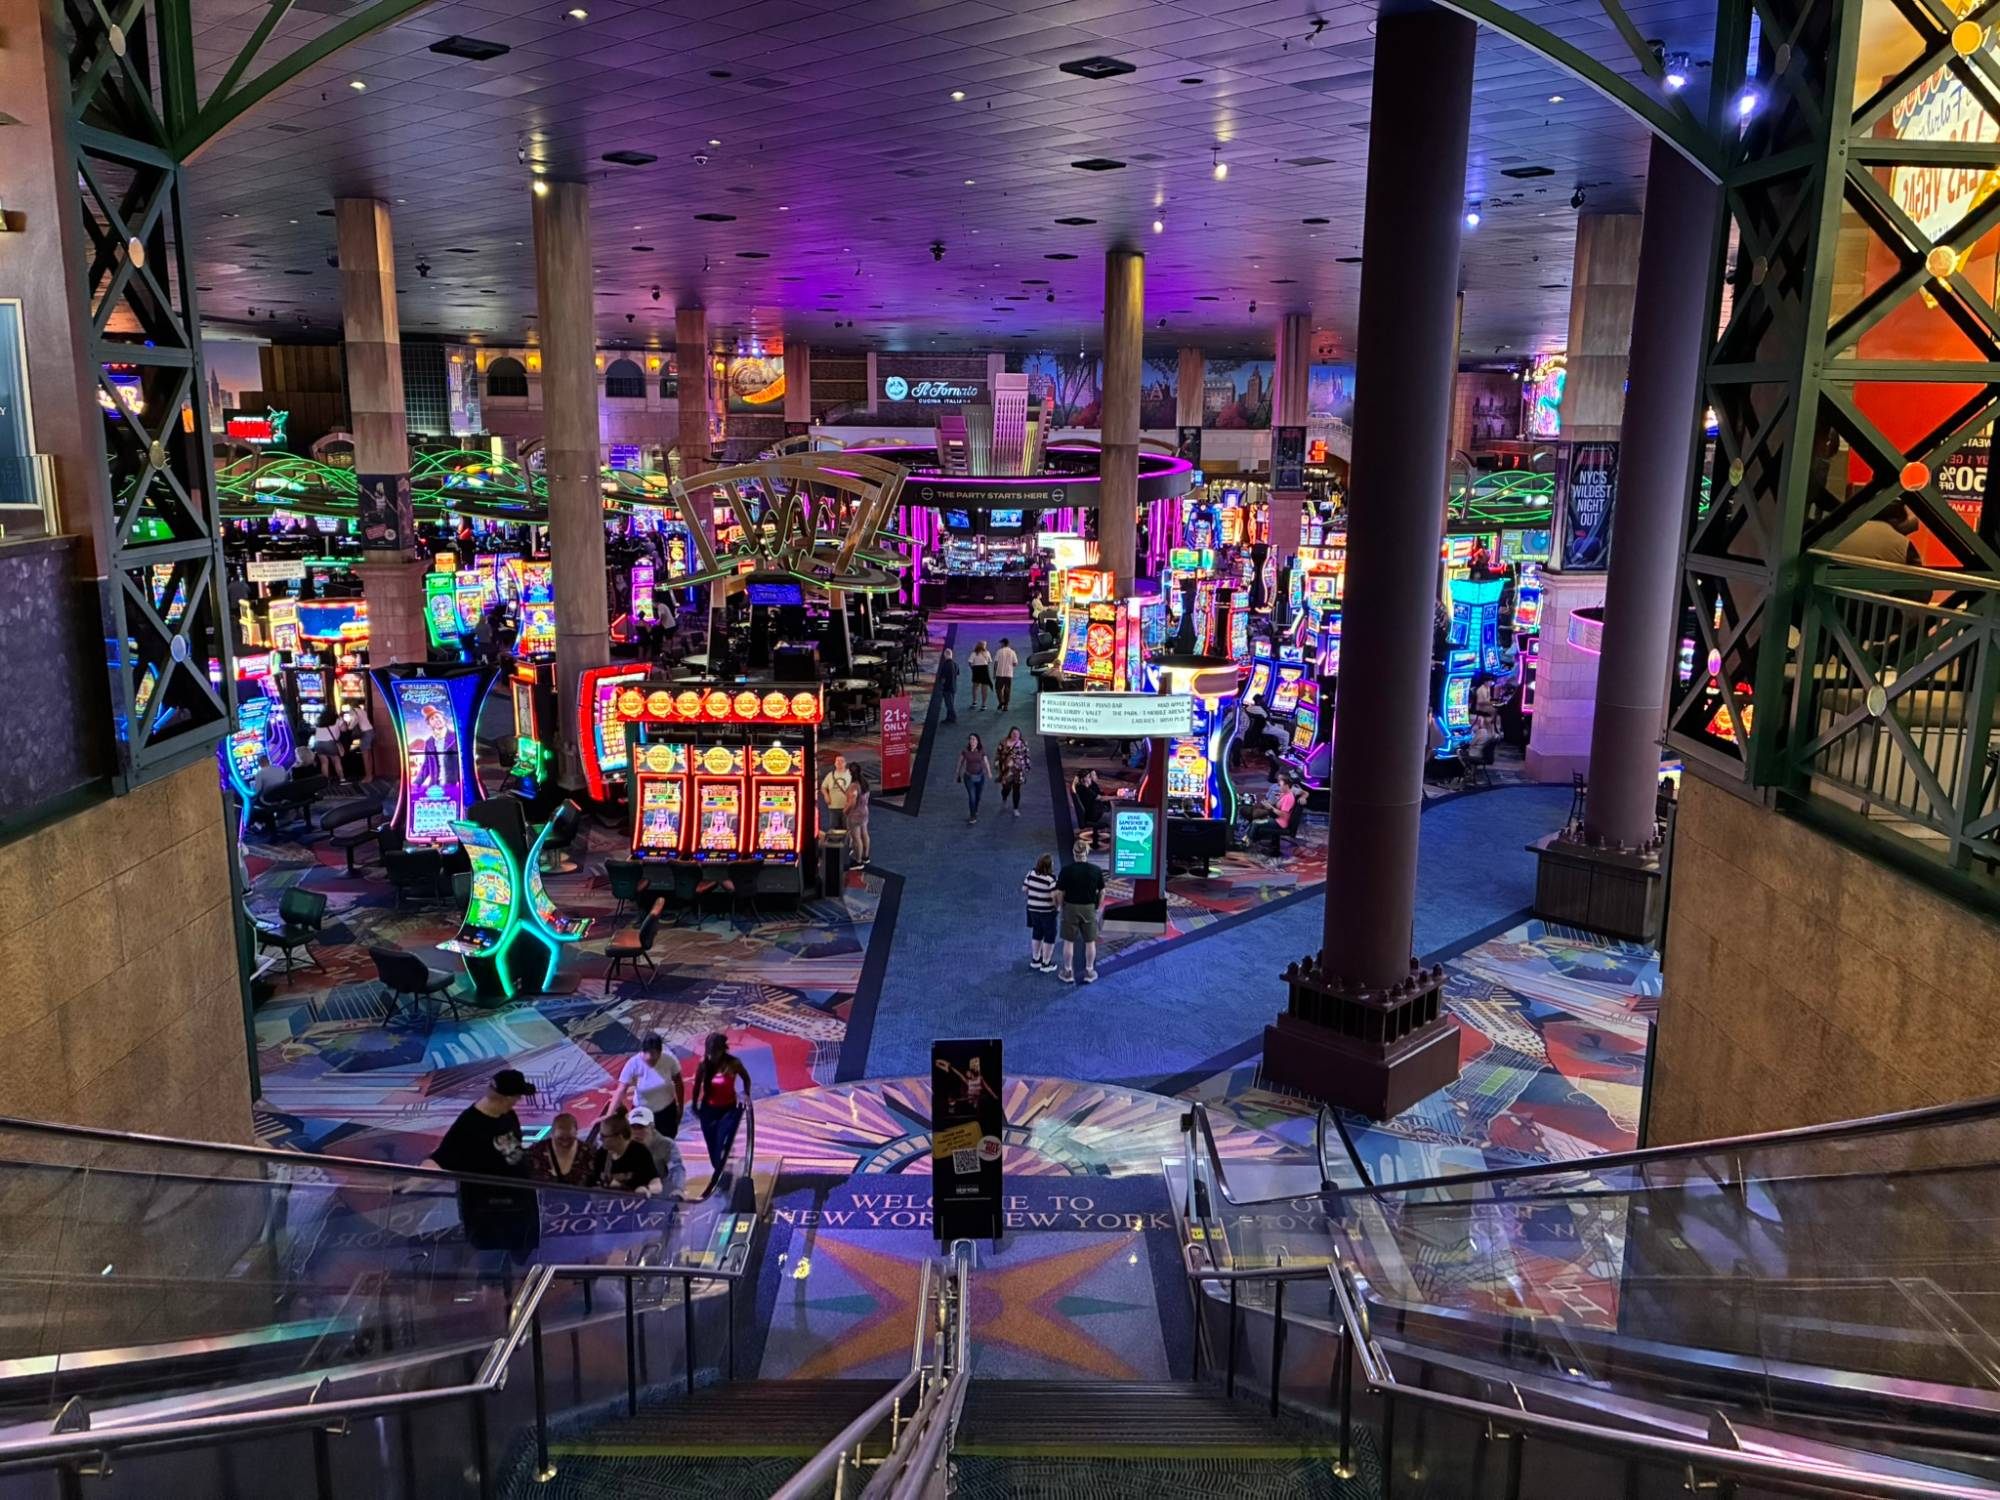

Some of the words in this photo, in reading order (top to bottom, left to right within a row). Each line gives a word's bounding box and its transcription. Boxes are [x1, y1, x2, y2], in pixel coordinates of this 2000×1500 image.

[1580, 470, 1608, 484] NYC'S
[936, 491, 954, 499] THE
[956, 491, 986, 499] PARTY
[986, 491, 1023, 500] STARTS
[1023, 492, 1049, 500] HERE
[1572, 484, 1612, 498] WILDEST
[1577, 498, 1605, 512] NIGHT
[1580, 512, 1599, 526] OUT
[884, 708, 908, 722] 21+
[883, 721, 908, 732] ONLY
[1047, 1195, 1095, 1211] TO
[772, 1209, 855, 1226] NEW
[866, 1211, 934, 1227] YOR
[1005, 1212, 1060, 1228] EW
[1069, 1213, 1173, 1229] YORK
